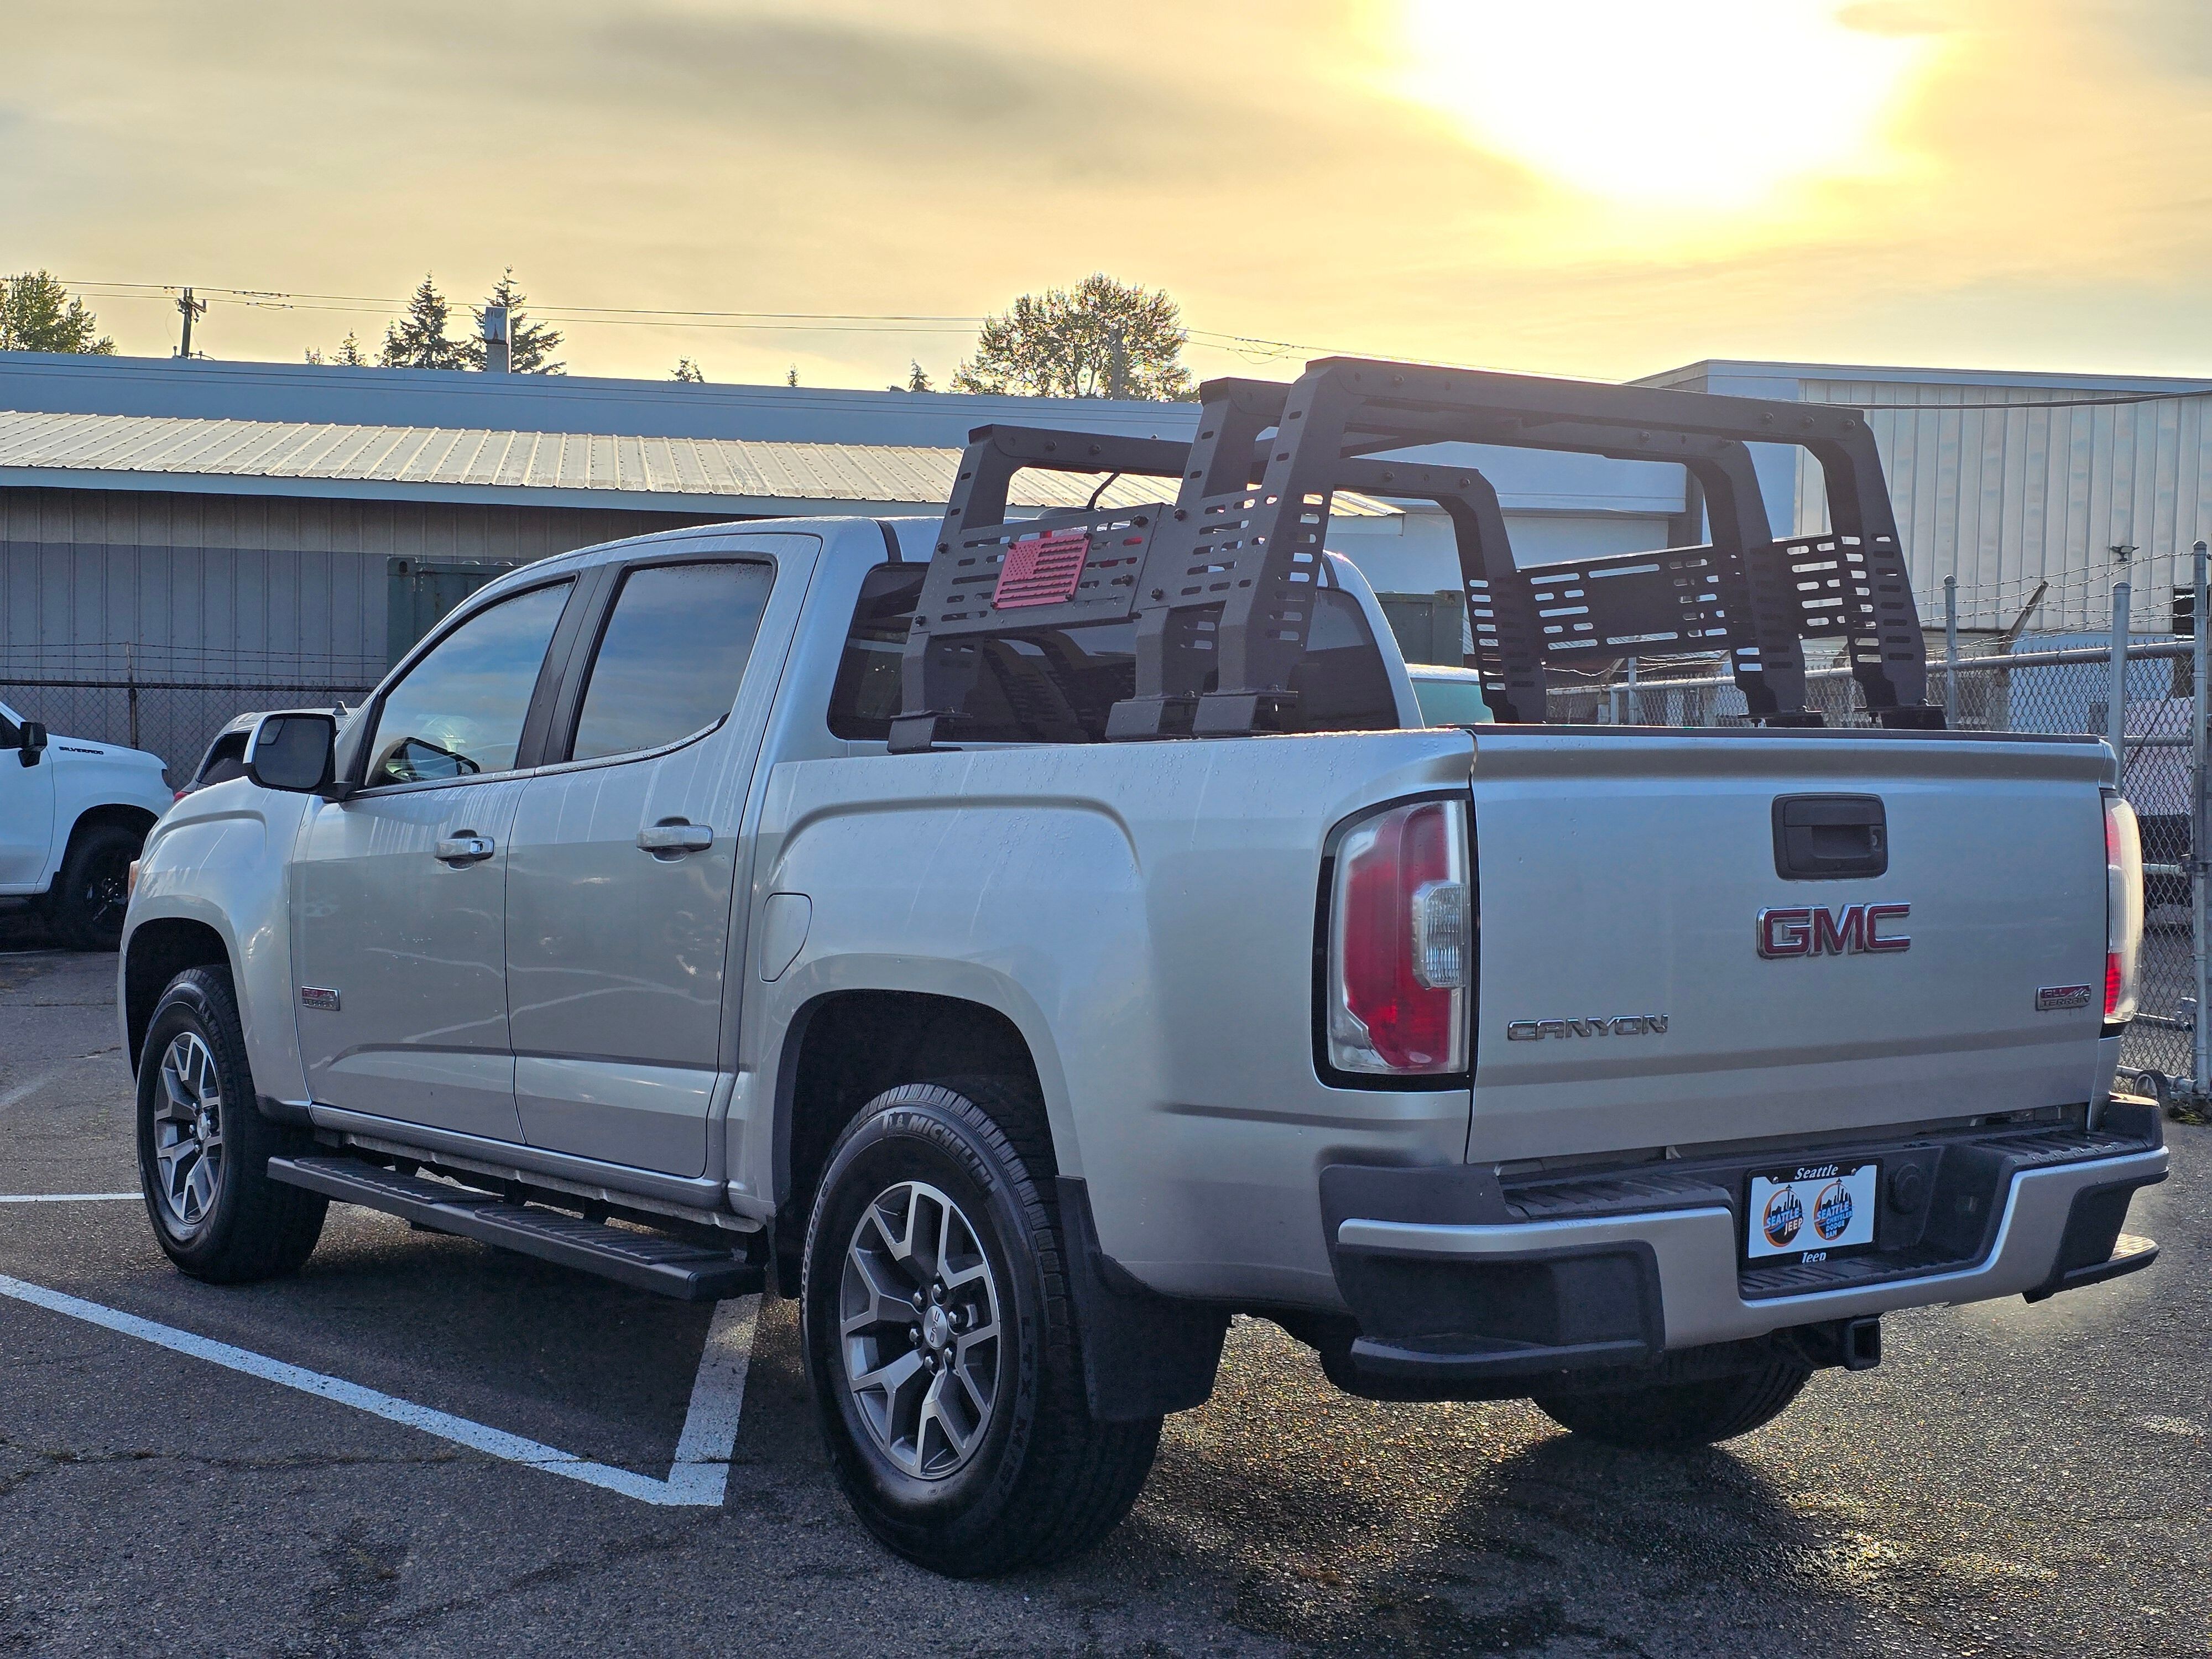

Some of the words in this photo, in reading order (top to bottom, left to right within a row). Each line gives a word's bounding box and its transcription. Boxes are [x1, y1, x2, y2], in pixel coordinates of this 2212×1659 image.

[1757, 902, 1911, 959] GMC
[2043, 997, 2088, 1006] TERRAIN
[1508, 1014, 1669, 1041] CANYON
[907, 1114, 992, 1186] MICHELIN
[1794, 1164, 1839, 1180] Seattle
[1766, 1207, 1801, 1228] SEATTLE
[1817, 1201, 1849, 1220] SEATTLE
[1783, 1217, 1804, 1236] JEEP
[1825, 1220, 1845, 1232] DODGE
